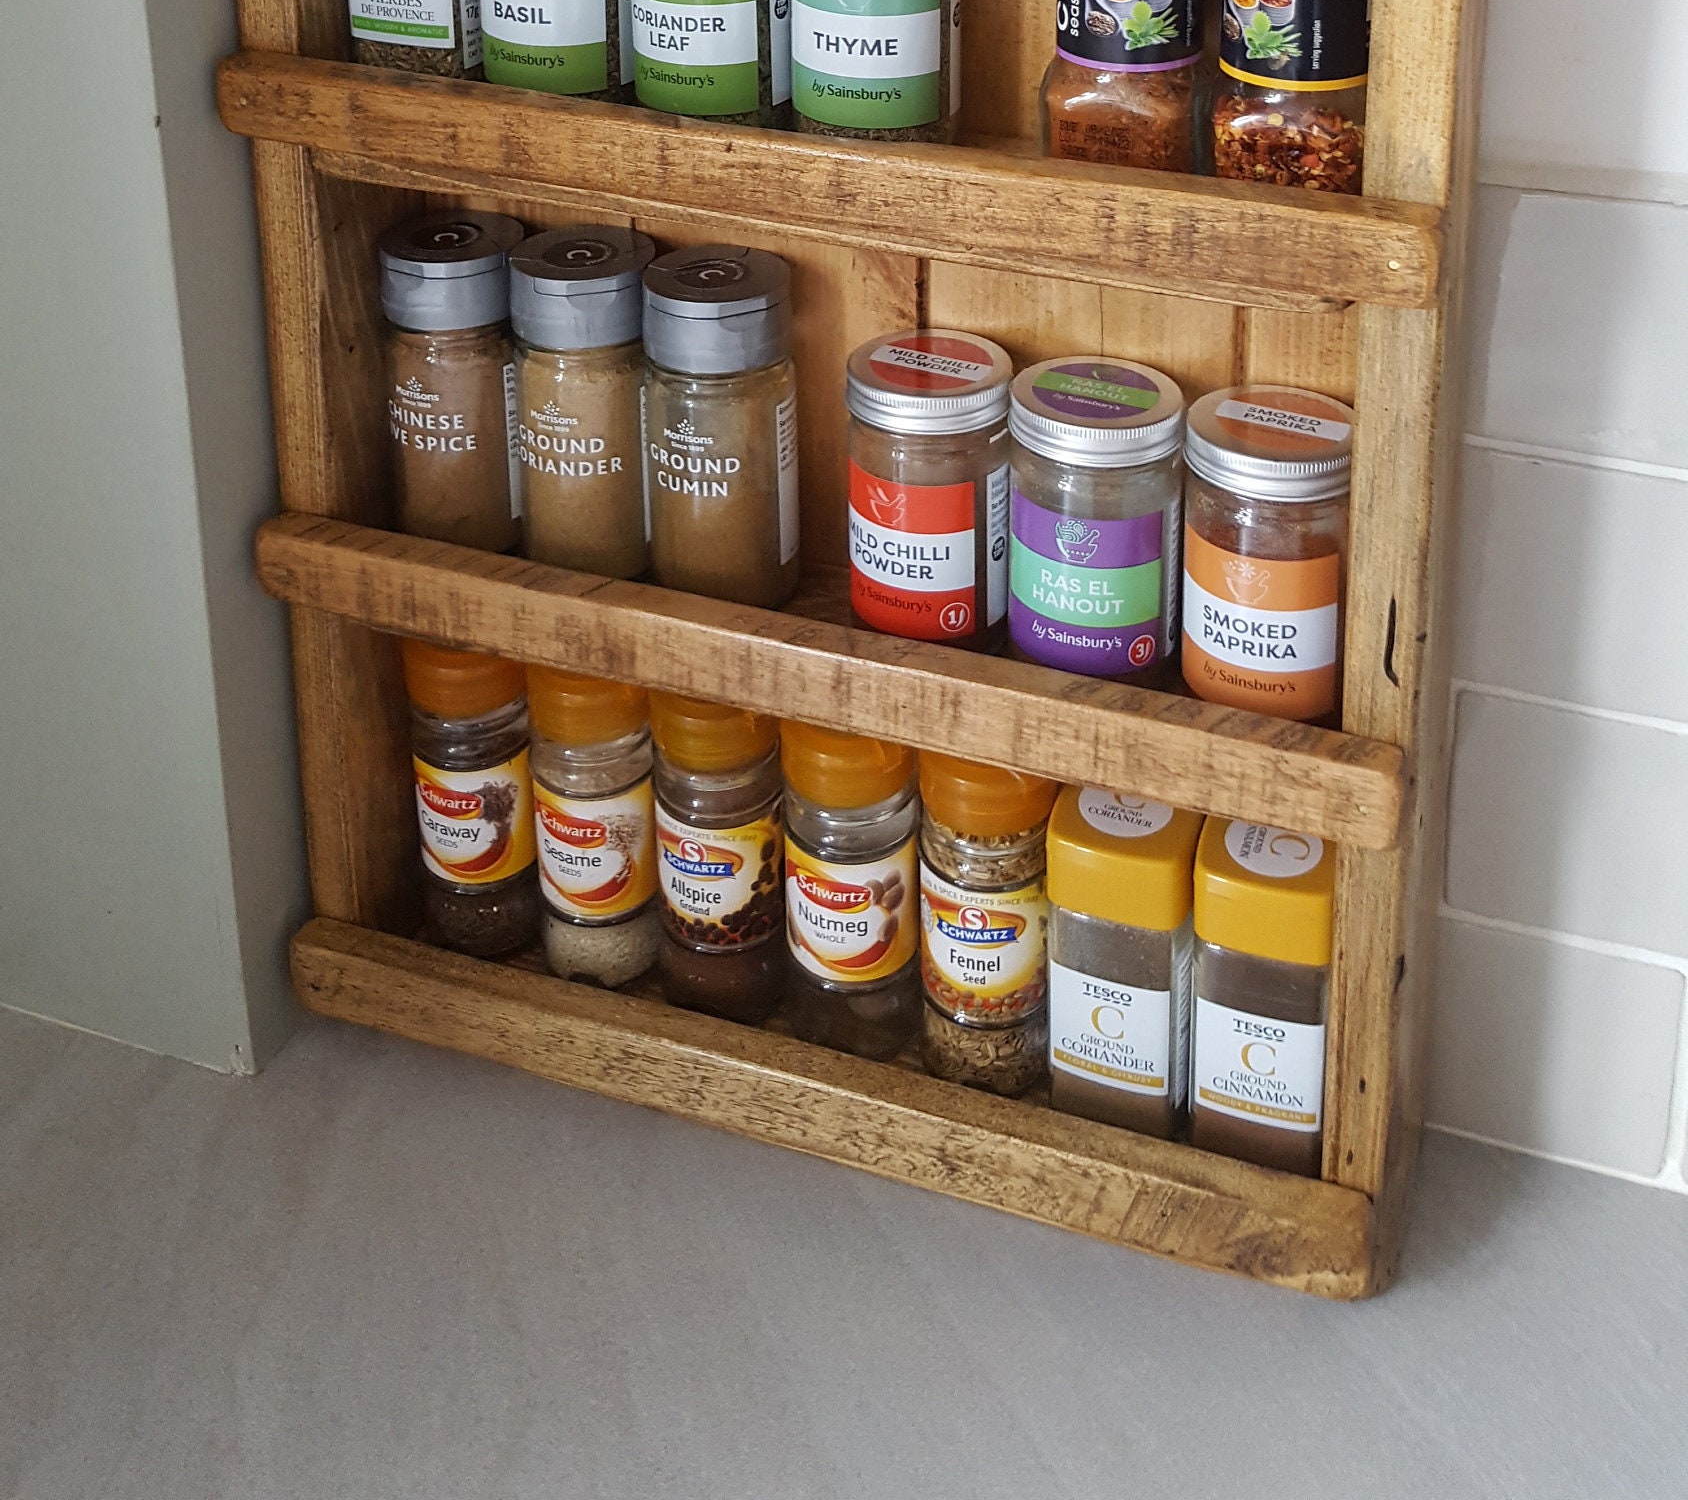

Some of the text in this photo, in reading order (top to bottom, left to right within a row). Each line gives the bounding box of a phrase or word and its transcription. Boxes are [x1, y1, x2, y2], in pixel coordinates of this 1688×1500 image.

[361, 3, 435, 21] DE PROVENCE
[493, 1, 552, 26] BASIL
[633, 3, 726, 33] CORIANDER
[649, 30, 690, 52] LEAF
[813, 31, 899, 56] THYME
[500, 48, 565, 69] Sainsbury's
[649, 67, 714, 88] Sainsbury's
[812, 79, 901, 102] by Sainsbury's
[889, 348, 980, 371] MILD CHILLI
[895, 356, 962, 375] POWDER
[396, 385, 439, 401] Morrisons
[530, 409, 578, 425] Morrisons
[1244, 412, 1316, 433] PAPRIKA
[1248, 407, 1321, 426] SMOKED
[415, 435, 477, 452] SPICE
[520, 424, 605, 454] GROUND
[664, 428, 714, 445] Morrisons
[520, 445, 623, 477] ORIANDER
[650, 443, 740, 474] GROUND
[658, 471, 728, 497] CUMIN
[850, 519, 950, 561] MILD CHILLI
[855, 544, 934, 581] POWDER
[1041, 568, 1114, 597] RAS EL
[866, 585, 932, 614] Sainsbury's
[1032, 584, 1124, 615] HANOUT
[1032, 619, 1122, 650] by Sainsbury's
[1203, 604, 1297, 640] SMOKED
[1203, 623, 1297, 660] PAPRIKA
[1203, 662, 1296, 694] by Sainsbury's
[420, 783, 477, 809] Schwartz
[422, 810, 480, 842] Caraway
[541, 810, 601, 837] Schwartz
[1088, 806, 1153, 828] CORIANDER
[544, 839, 602, 867] Sesame
[667, 851, 725, 873] SCHWARTZ
[671, 876, 721, 904] Allspice
[799, 874, 865, 902] Schwartz
[799, 901, 868, 937] Nutmeg
[941, 921, 1009, 940] SCHWARTZ
[814, 930, 847, 944] WHOLE
[950, 948, 1000, 972] Fennel
[963, 973, 986, 985] Seed
[1083, 981, 1132, 1002] TESCO
[1091, 1005, 1124, 1040] C
[1233, 1018, 1285, 1038] TESCO
[1061, 1037, 1155, 1072] CORIANDER
[1080, 1033, 1134, 1055] GROUND
[1241, 1042, 1276, 1076] C
[1213, 1076, 1303, 1107] CINNAMON
[1230, 1070, 1286, 1090] GROUND
